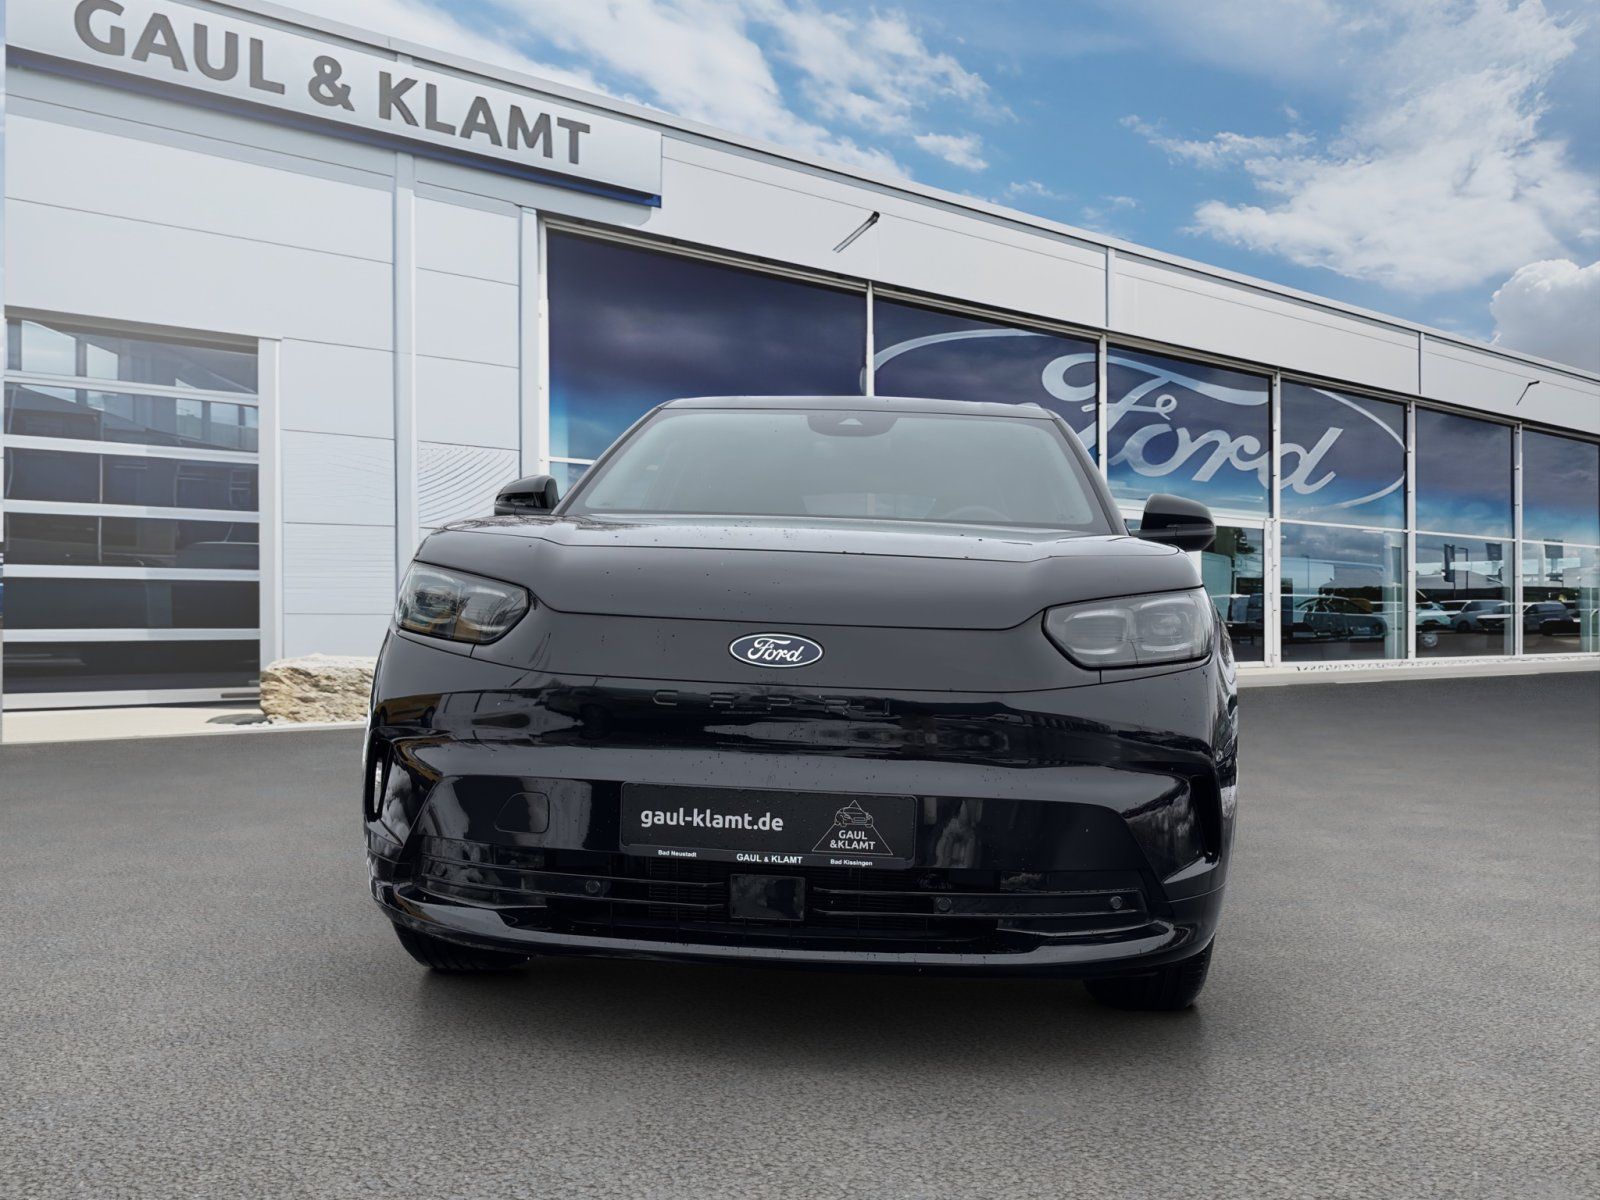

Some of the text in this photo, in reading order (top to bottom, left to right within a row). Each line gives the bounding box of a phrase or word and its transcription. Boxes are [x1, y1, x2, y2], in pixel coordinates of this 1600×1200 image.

[74, 0, 591, 165] GAUL & KLAMT
[1041, 352, 1344, 495] Ford
[747, 637, 805, 662] Ford
[640, 807, 785, 832] gaul-klamt.de
[838, 829, 868, 840] GAUL
[829, 839, 876, 850] &KLAMT
[670, 850, 697, 858] Neustadt
[736, 853, 762, 862] GAUL
[771, 855, 804, 864] KLAMT
[830, 858, 873, 867] Bad Kissingen
